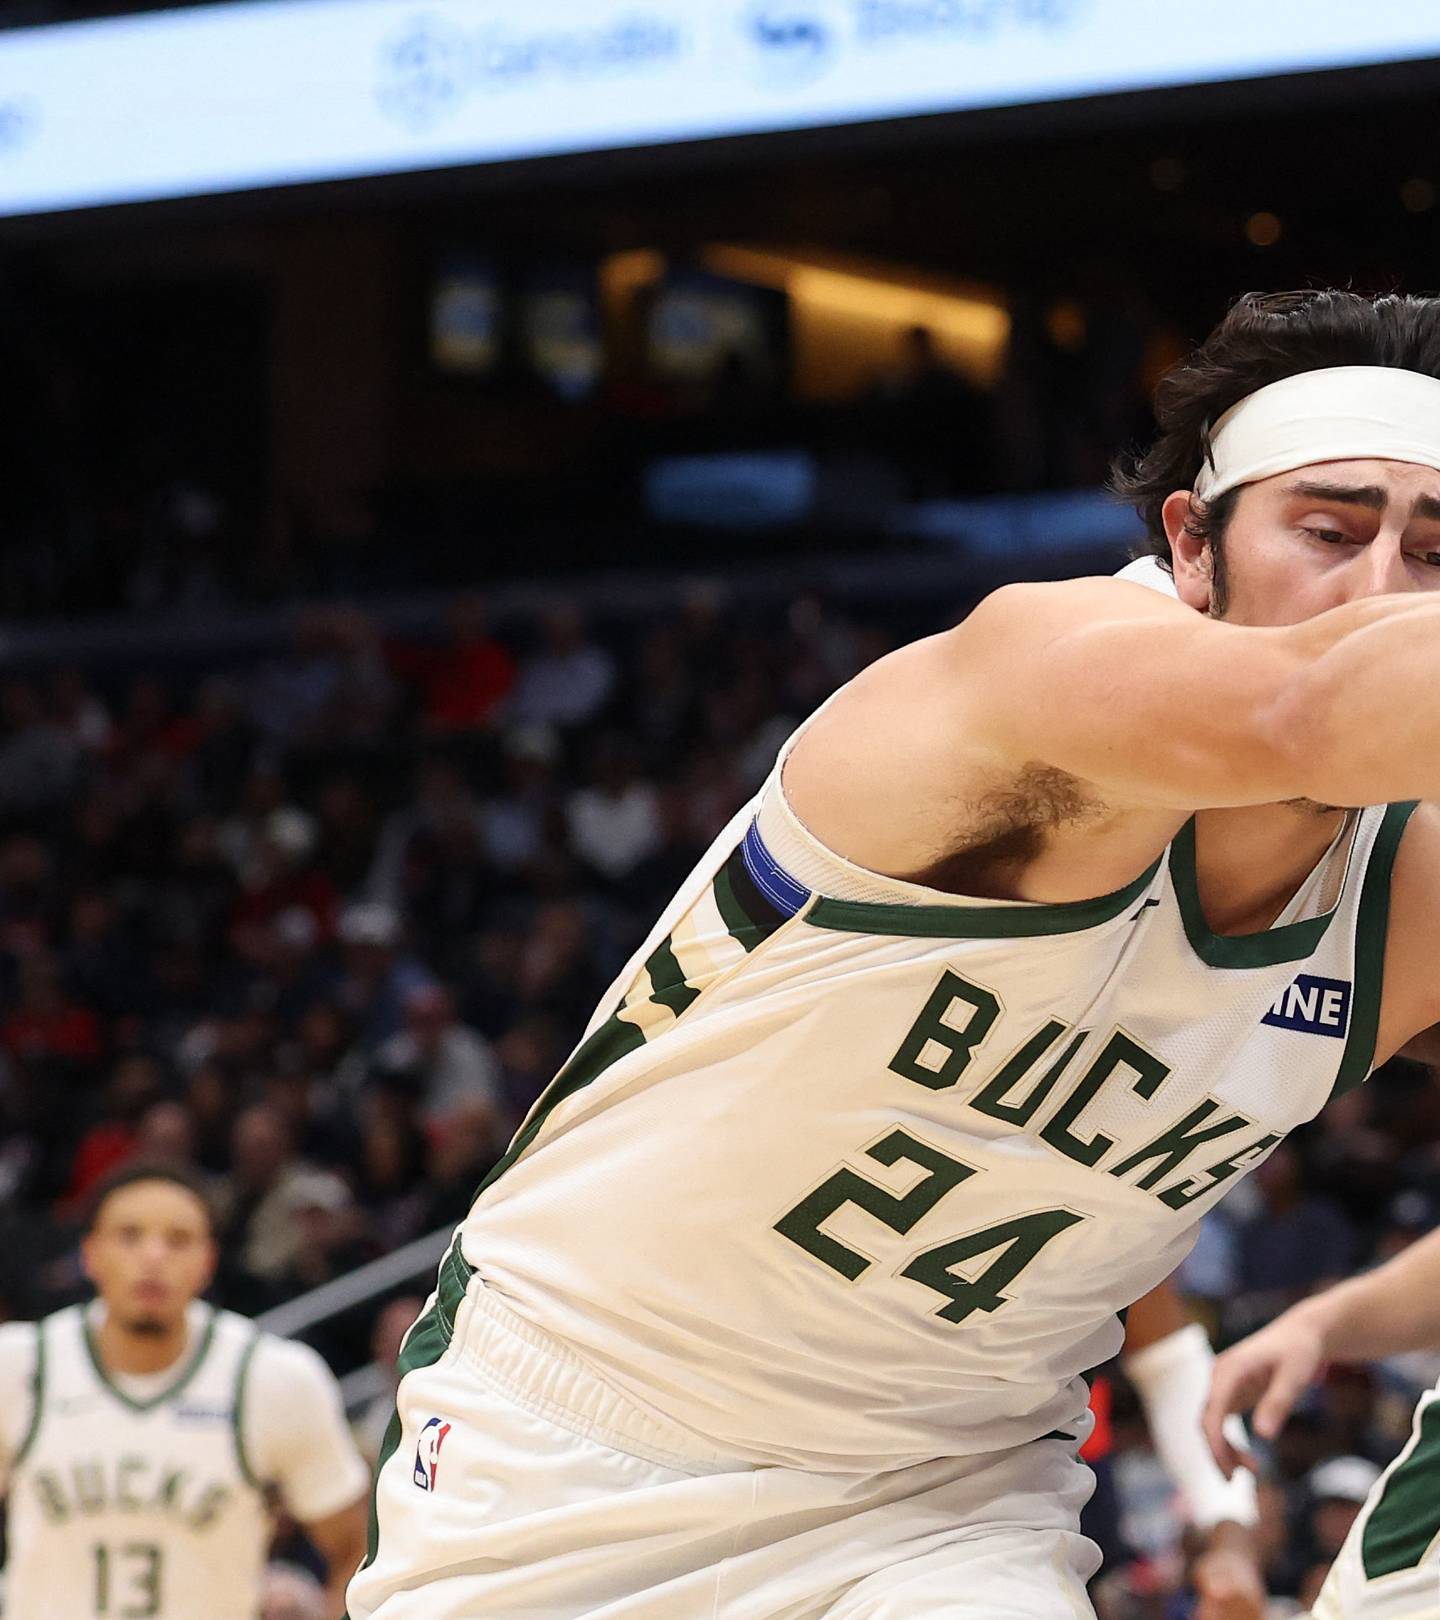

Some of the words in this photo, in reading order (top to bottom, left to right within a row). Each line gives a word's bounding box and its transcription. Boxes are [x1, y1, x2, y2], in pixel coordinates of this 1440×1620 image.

[887, 967, 1286, 1211] BUCKS
[772, 1128, 1088, 1325] 24
[94, 1543, 162, 1618] 13
